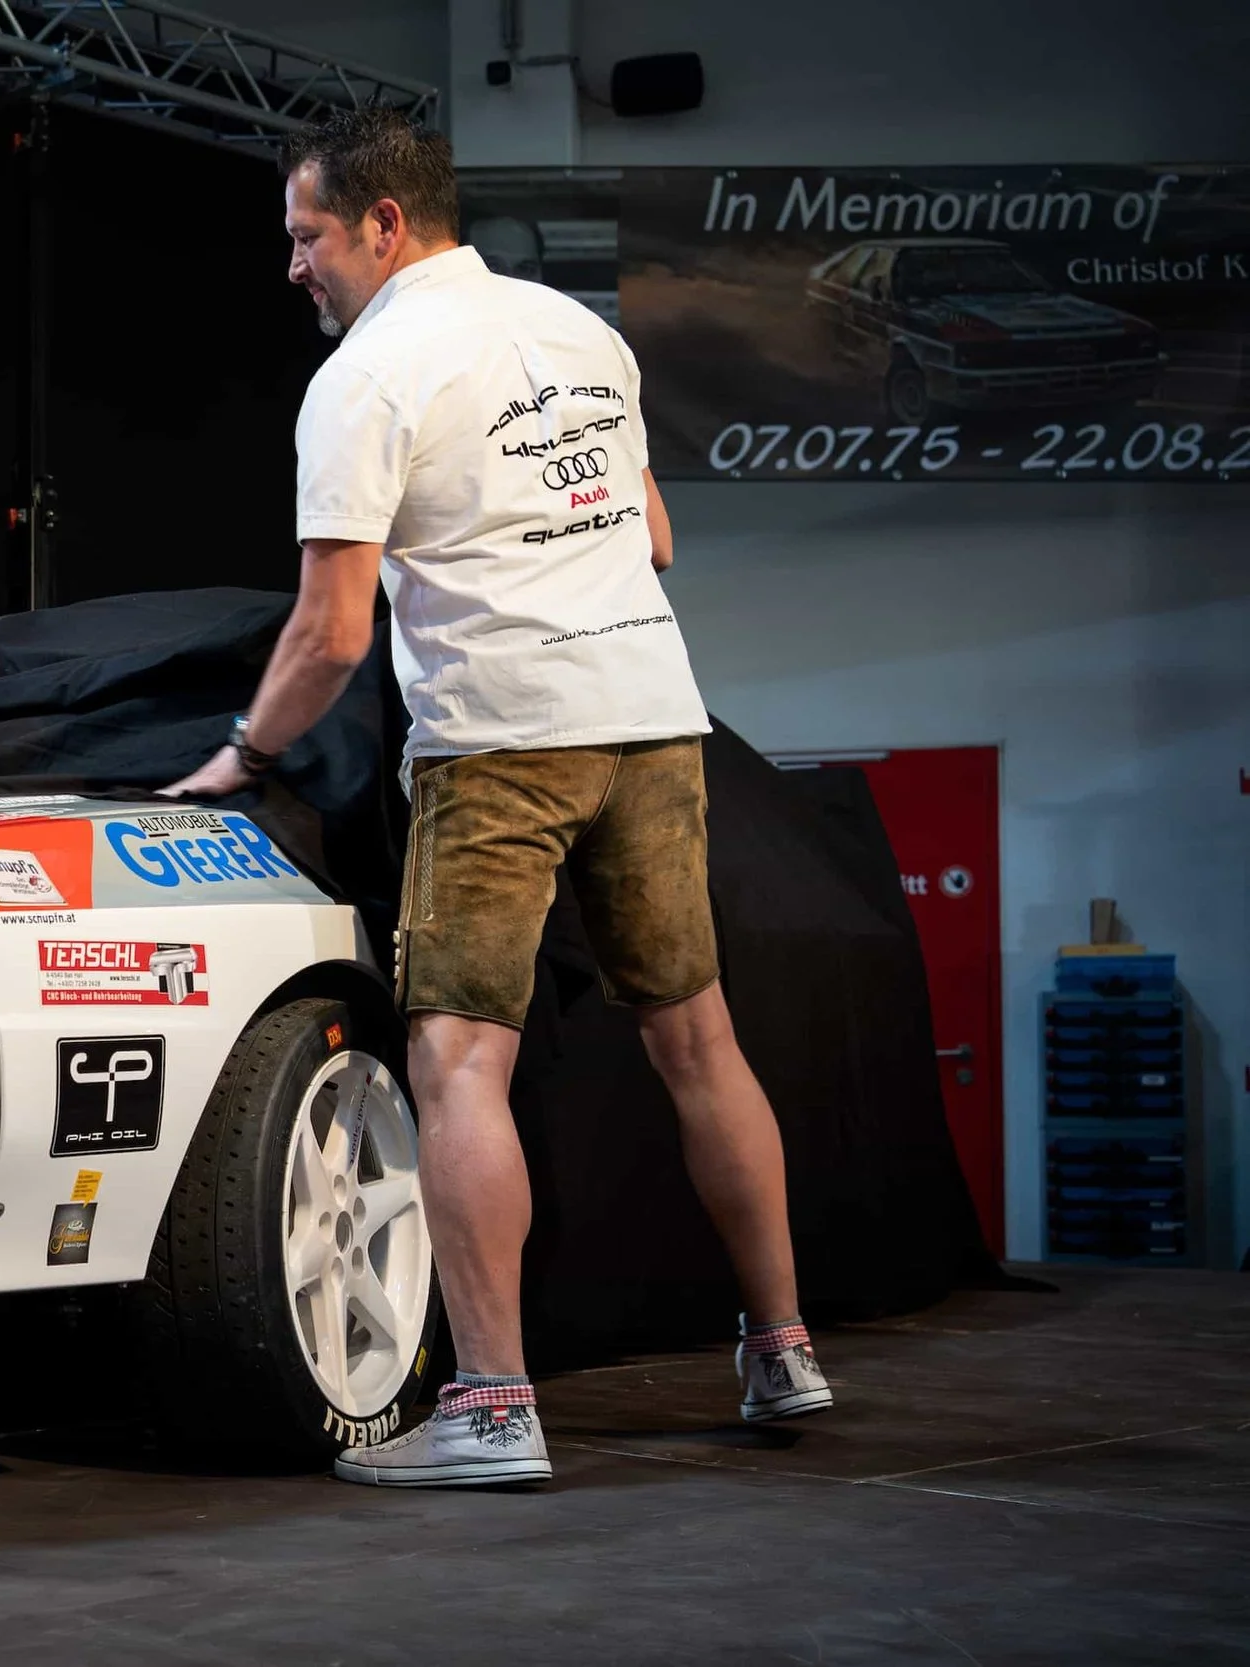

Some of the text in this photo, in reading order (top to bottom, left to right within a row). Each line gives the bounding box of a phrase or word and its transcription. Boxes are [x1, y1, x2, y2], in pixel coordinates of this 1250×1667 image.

[703, 174, 1179, 244] In Memoriam of
[1066, 256, 1209, 287] Christof
[502, 414, 627, 458] klausner
[708, 423, 961, 472] 07.07.75
[570, 485, 610, 509] Audi
[522, 506, 641, 545] quattro
[137, 813, 223, 833] AUTOMOBILE
[104, 816, 300, 888] GIERER
[43, 942, 141, 968] TERSCHL
[65, 1130, 148, 1143] PHI OIL
[322, 1400, 401, 1449] PIRELLI
